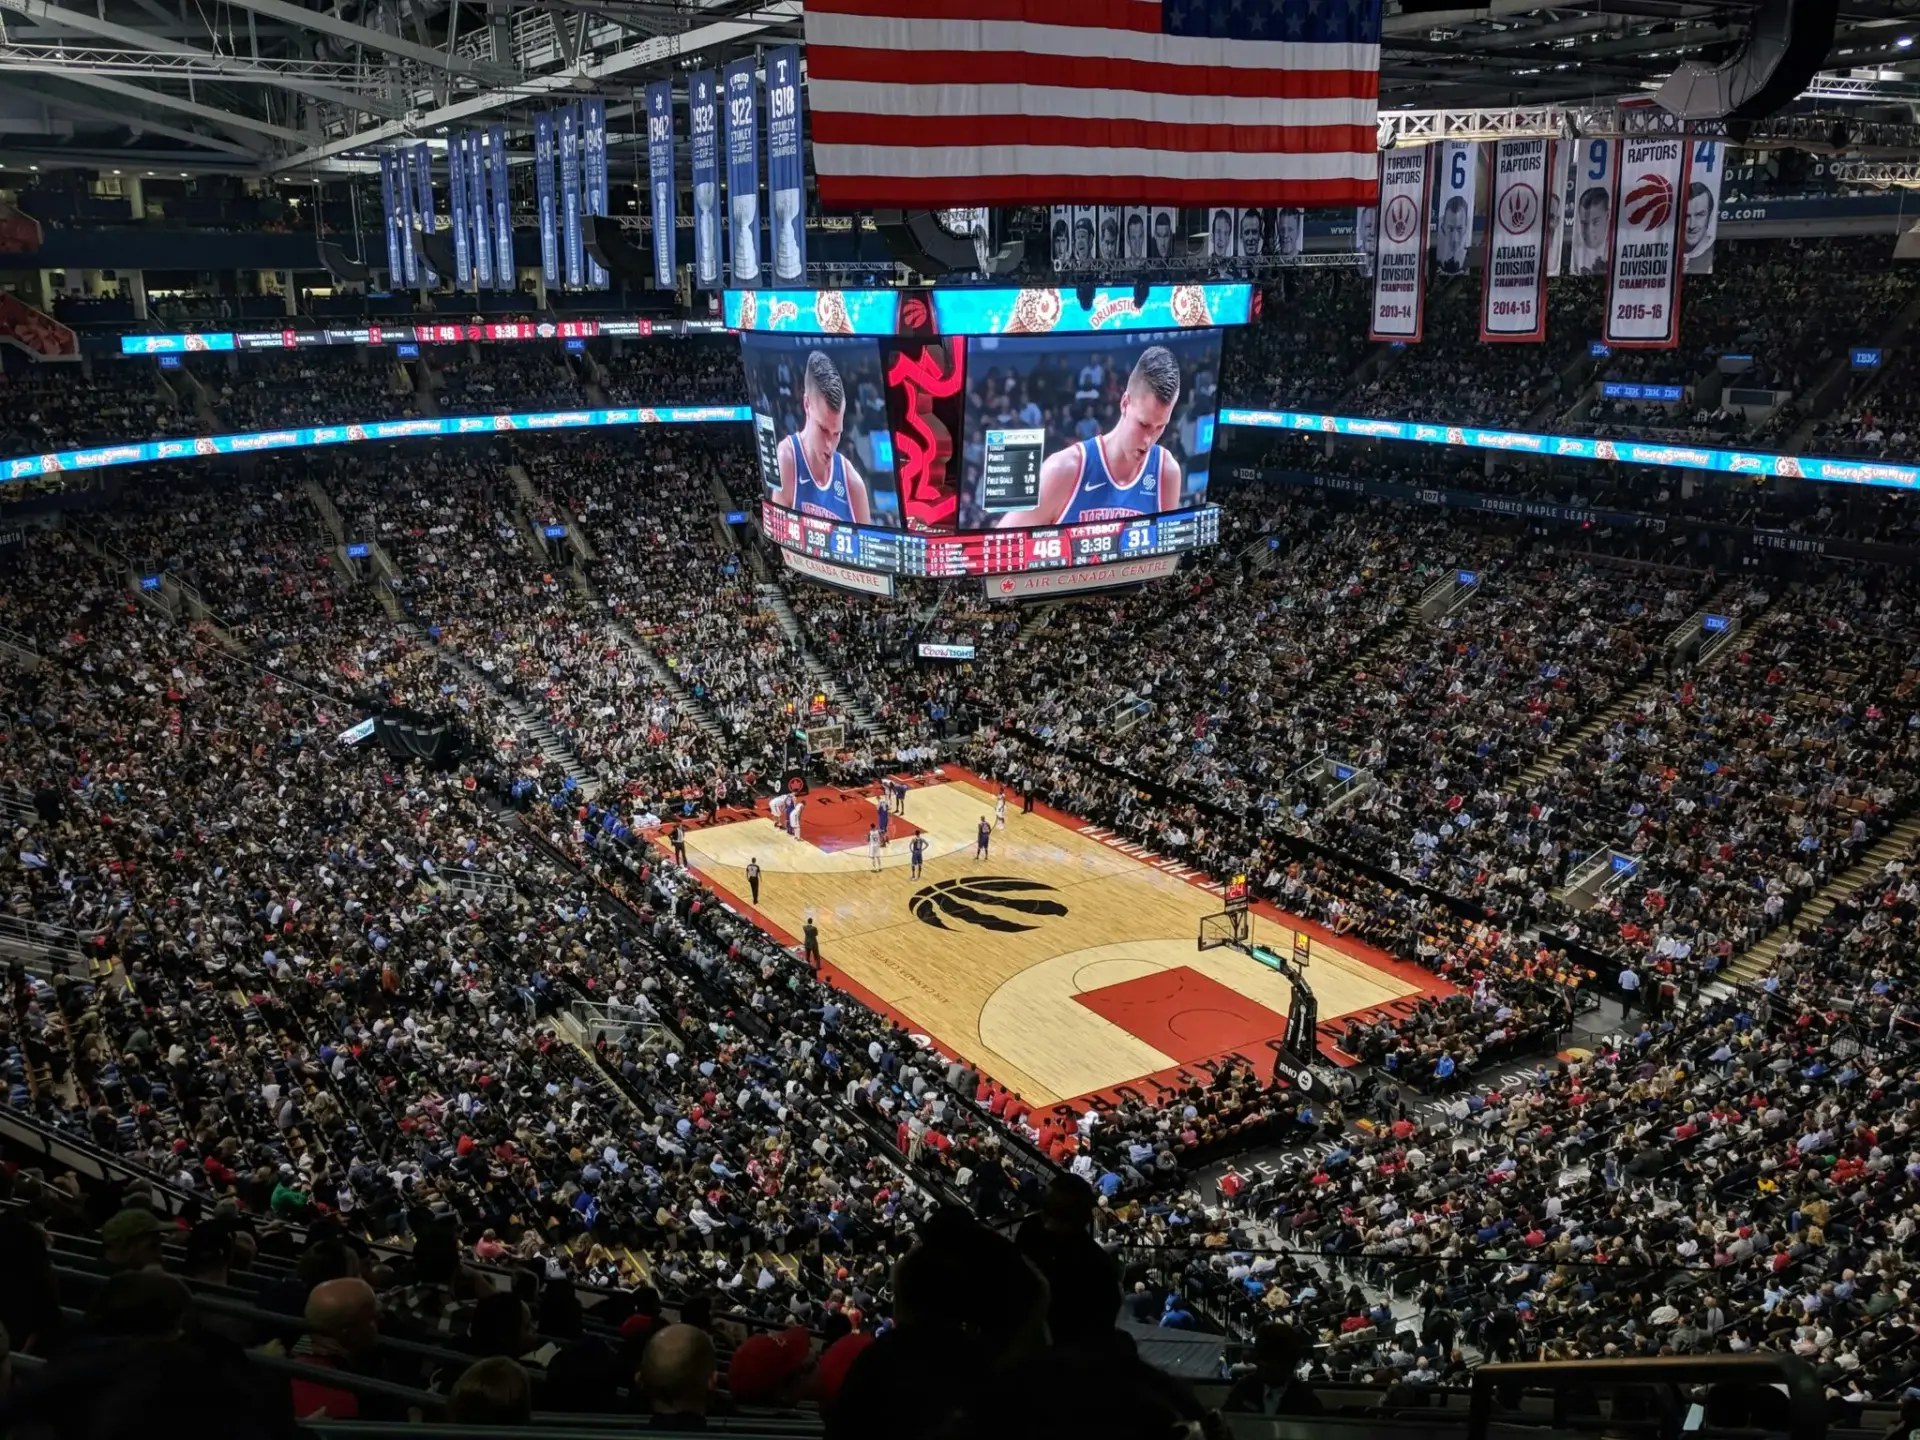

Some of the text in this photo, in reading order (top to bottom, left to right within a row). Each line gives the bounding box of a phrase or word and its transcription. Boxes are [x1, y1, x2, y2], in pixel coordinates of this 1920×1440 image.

[776, 59, 787, 82] T
[771, 86, 795, 118] 1918
[729, 96, 752, 126] 922
[693, 104, 714, 134] 1932
[772, 118, 796, 134] STANLEY
[650, 115, 669, 142] 1942
[1501, 140, 1543, 157] TORONTO
[1627, 144, 1678, 164] RAPTORS
[1694, 139, 1716, 173] 4
[1387, 155, 1422, 169] TORONTO
[1500, 156, 1541, 174] RAPTORS
[1588, 138, 1608, 180] 9
[1451, 151, 1467, 189] 6
[1385, 171, 1421, 185] RAPTORS
[1496, 245, 1536, 260] ATLANTIC
[1621, 242, 1669, 259] ATLANTIC
[1382, 253, 1416, 266] ATLANTIC
[1381, 268, 1415, 282] DIVISION
[1494, 260, 1535, 276] DIVISION
[1619, 259, 1667, 277] DIVISION
[1380, 283, 1414, 293] CHAMPIONS
[1494, 276, 1534, 288] CHAMPIONS
[1618, 277, 1666, 289] CHAMPIONS
[1379, 305, 1411, 318] 2013-14
[1493, 300, 1531, 315] 2014-15
[1617, 304, 1662, 320] 2015-16
[440, 326, 455, 340] 46
[495, 325, 518, 338] 3:38
[564, 323, 577, 336] 31
[400, 346, 416, 354] IBM
[1593, 345, 1609, 354] IBM
[161, 356, 178, 365] IBM
[1856, 353, 1876, 364] IBM
[1028, 451, 1035, 460] 4
[1028, 463, 1034, 471] 2
[1024, 485, 1034, 494] 15
[1327, 479, 1350, 490] LEAFS
[1424, 491, 1438, 501] 107
[1482, 499, 1596, 523] TORONTO MAPLE LEAFS
[547, 528, 562, 536] IBM
[808, 530, 826, 547] 3:38
[1032, 530, 1059, 538] RAPTORS
[1128, 528, 1150, 548] 31
[836, 534, 853, 553] 31
[1032, 540, 1061, 558] 46
[1080, 537, 1111, 553] 3:38
[1753, 535, 1825, 553] WE THE NORTH
[806, 560, 838, 577] CANADA
[841, 570, 881, 587] CENTRE
[1025, 561, 1168, 589] AIR CANADA CENTRE
[1460, 573, 1475, 583] IBM
[1707, 618, 1725, 629] IBM
[923, 645, 948, 657] Coors
[1229, 884, 1244, 898] 24
[1279, 1062, 1297, 1079] BMO
